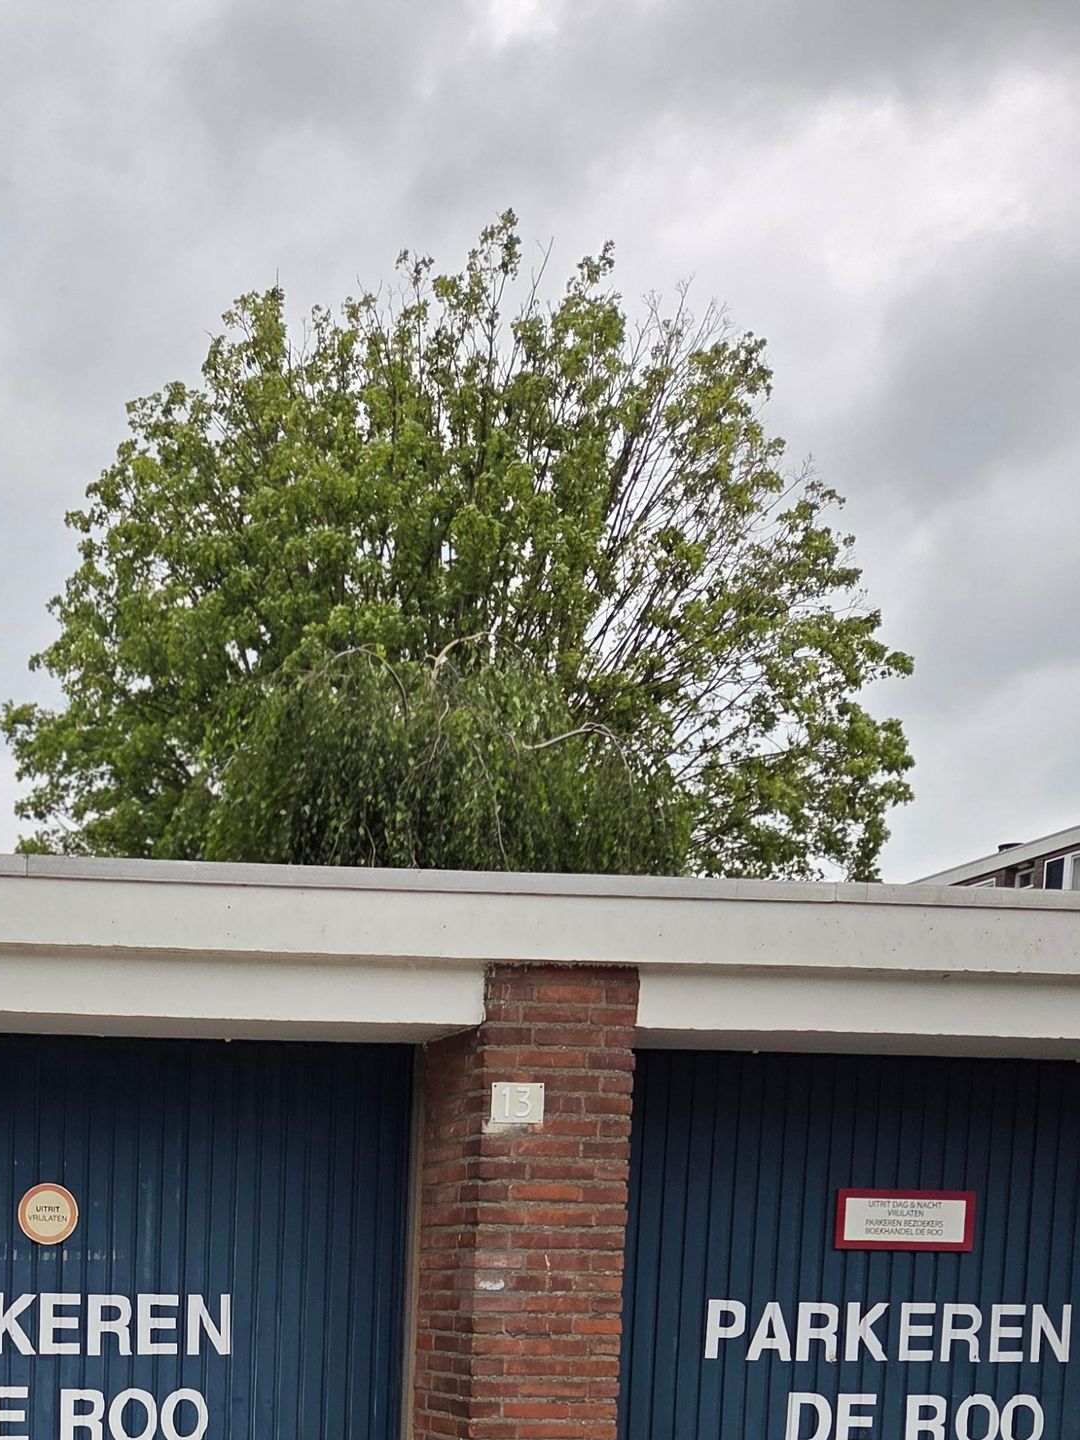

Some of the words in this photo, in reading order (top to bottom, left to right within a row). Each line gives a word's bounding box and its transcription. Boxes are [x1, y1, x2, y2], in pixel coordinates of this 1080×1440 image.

[501, 1086, 532, 1118] 13
[35, 1205, 60, 1213] UITRIT
[868, 1200, 890, 1208] UITRIT
[892, 1201, 908, 1209] DAG
[909, 1201, 916, 1209] &
[917, 1201, 942, 1209] NACHT
[887, 1209, 924, 1218] VRIJLATEN
[27, 1214, 68, 1223] VRIJLATEN
[865, 1219, 902, 1227] PARKEREN
[904, 1220, 944, 1228] BEZOEKERS
[865, 1228, 914, 1236] BOEKHANDEL
[915, 1228, 926, 1236] DE
[926, 1228, 944, 1237] ROO
[704, 1299, 1072, 1363] PARKEREN
